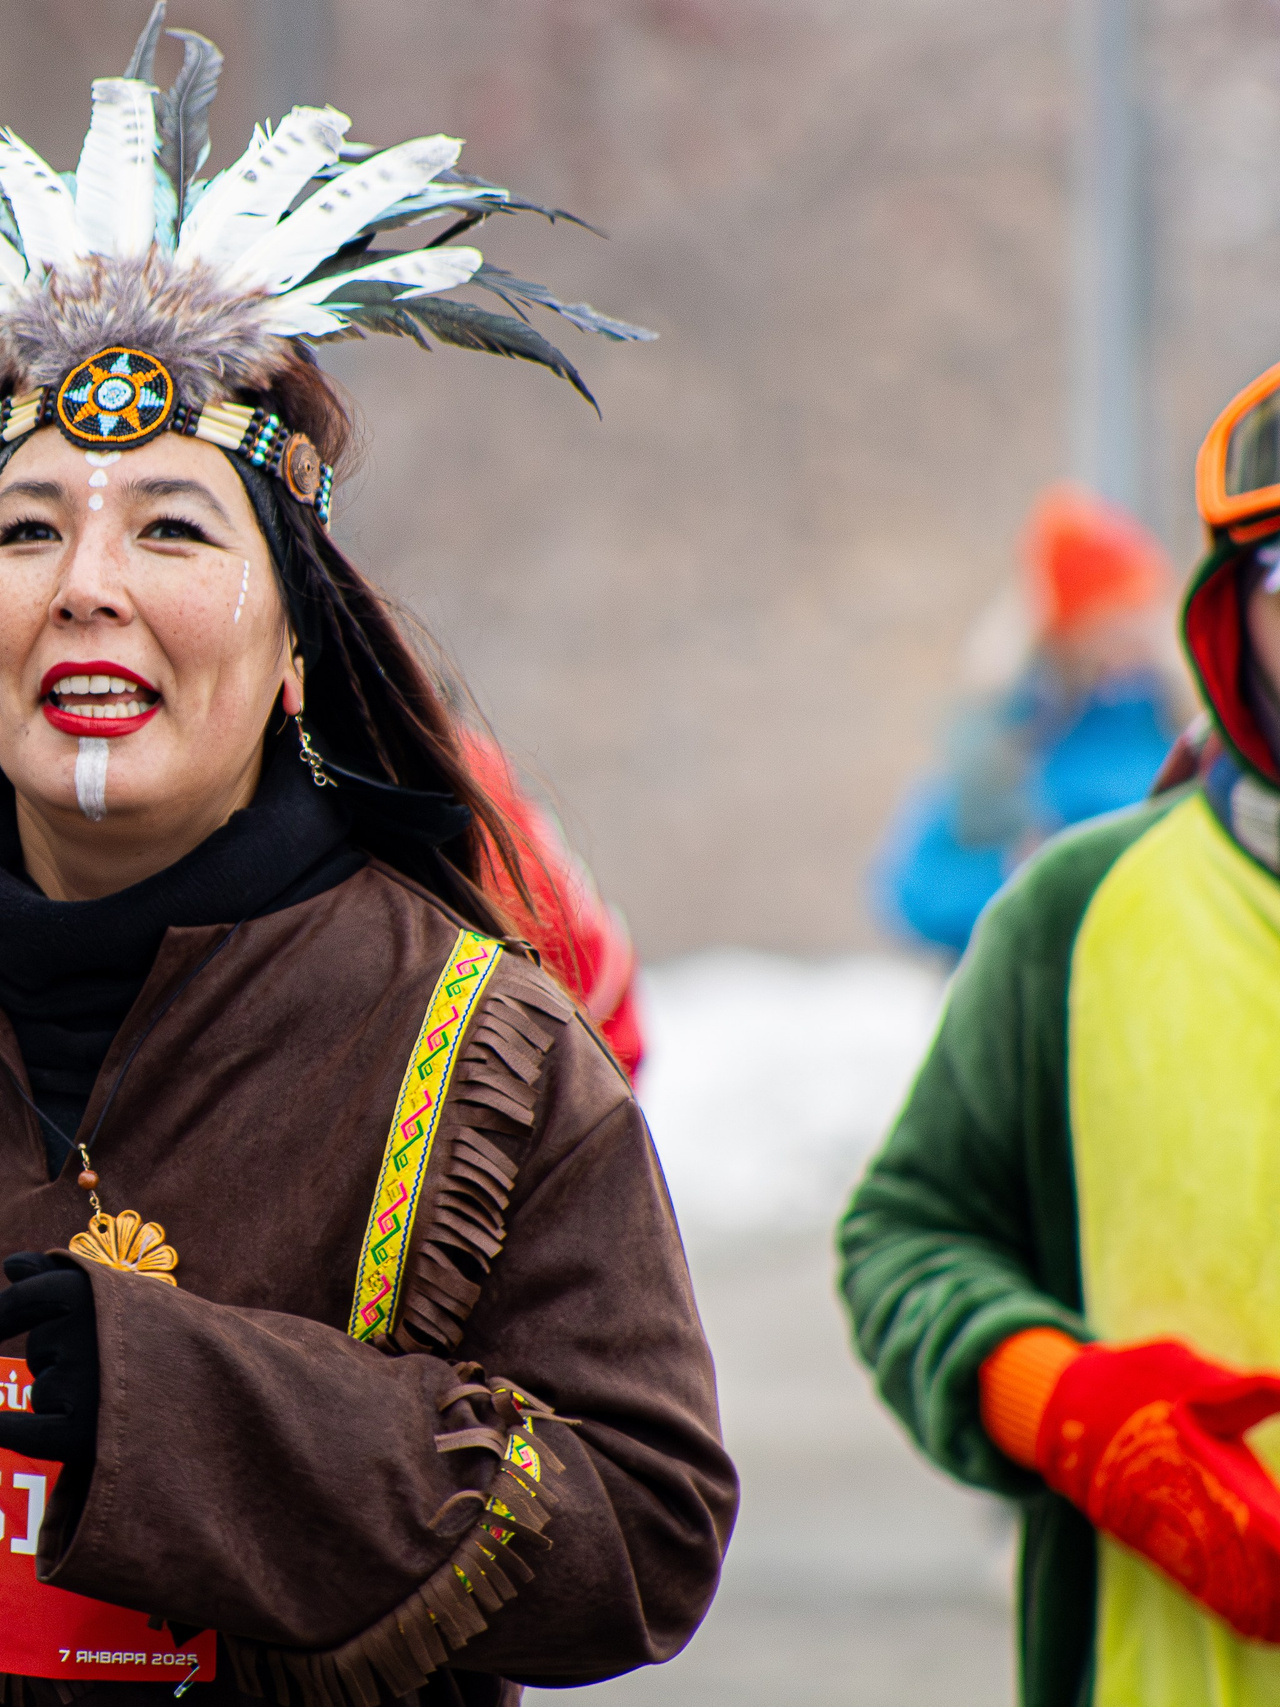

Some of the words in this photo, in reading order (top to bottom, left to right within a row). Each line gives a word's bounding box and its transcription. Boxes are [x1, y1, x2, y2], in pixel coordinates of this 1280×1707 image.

[59, 1649, 70, 1663] 7
[75, 1650, 147, 1666] ЯНВАРЯ
[151, 1653, 198, 1666] 2025
